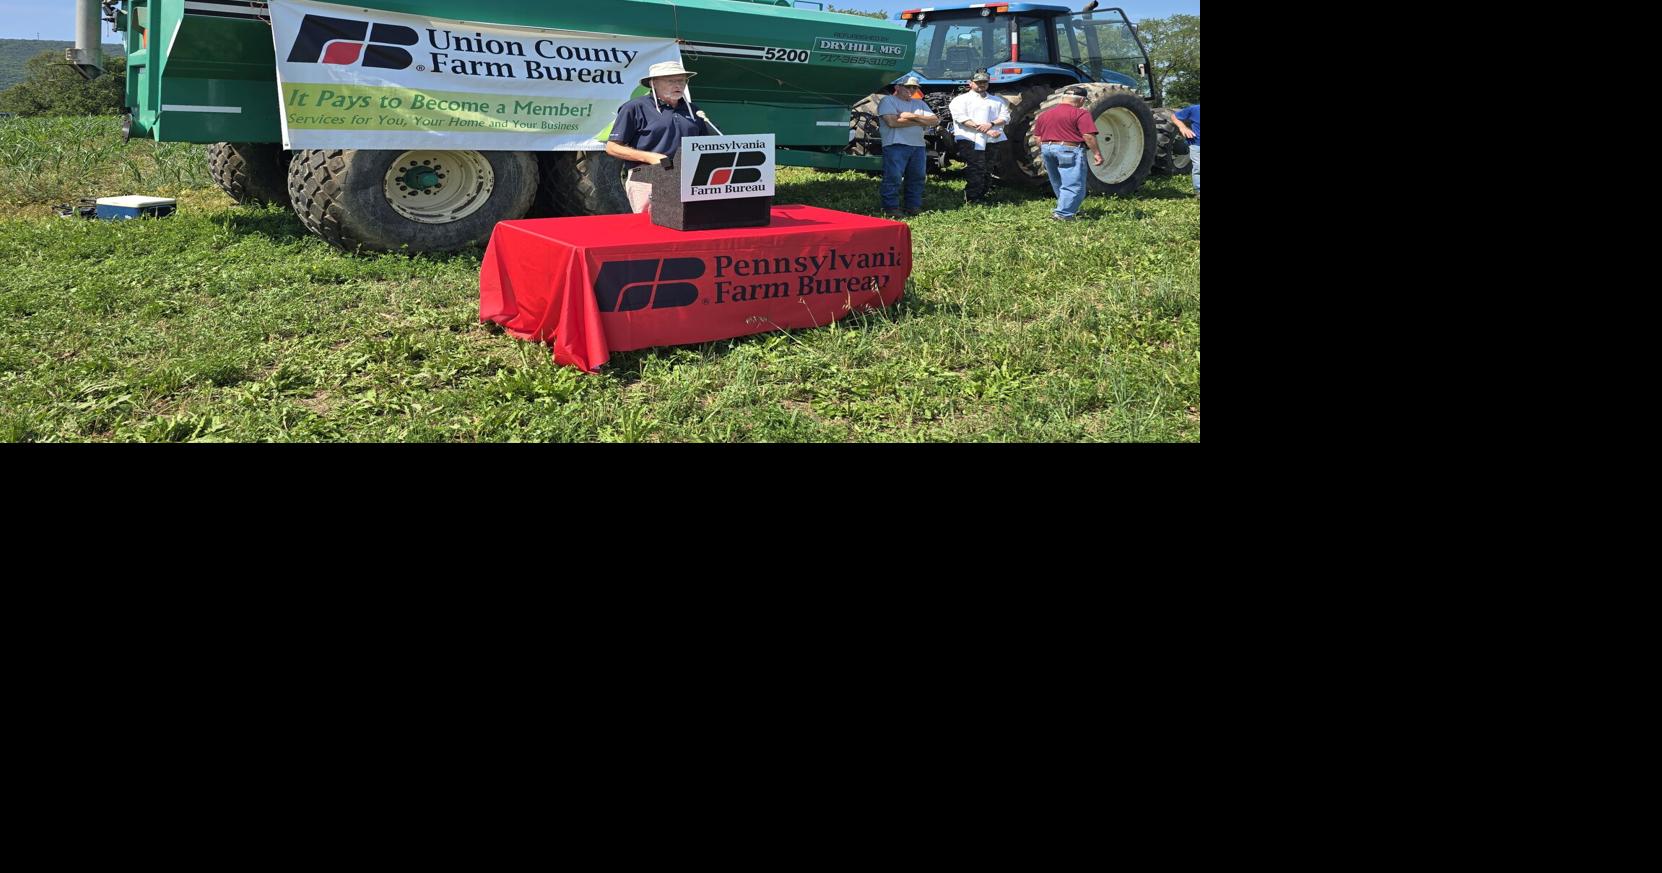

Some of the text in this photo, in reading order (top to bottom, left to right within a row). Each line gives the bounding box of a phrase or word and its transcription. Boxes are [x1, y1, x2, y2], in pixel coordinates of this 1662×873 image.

[426, 28, 639, 68] Union County
[764, 48, 808, 62] 5200
[820, 40, 901, 55] DRYHILL MFG
[430, 52, 624, 85] Farm Bureau
[288, 89, 592, 117] It Pays to Become a Member!
[288, 113, 579, 131] Services for You, Your Home and Your Business
[691, 139, 766, 152] Pennsylvania
[691, 184, 766, 196] Farm Bureau
[714, 279, 790, 304] Farm
